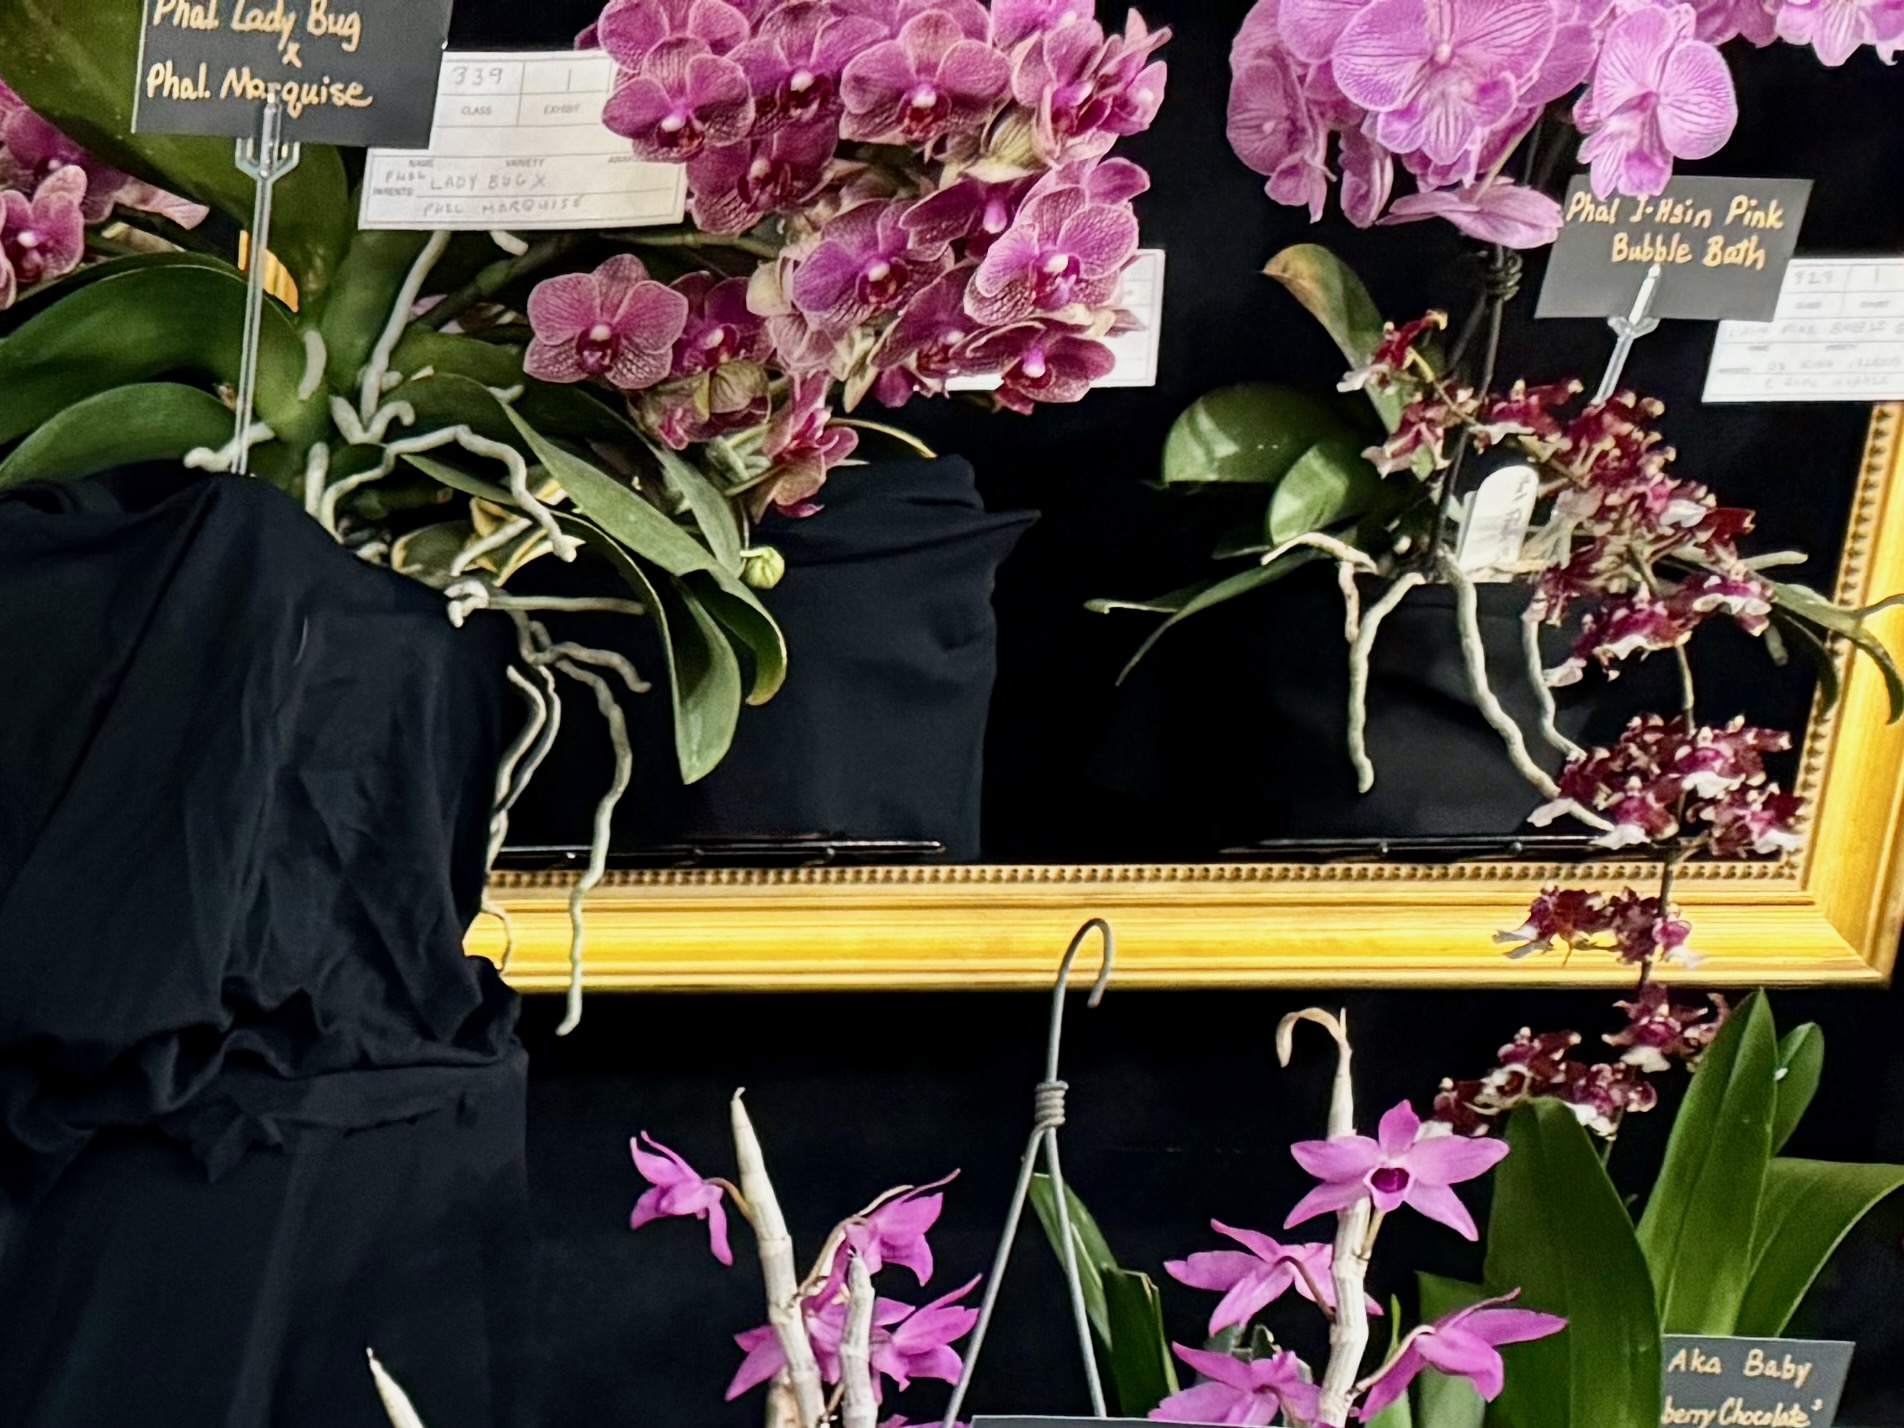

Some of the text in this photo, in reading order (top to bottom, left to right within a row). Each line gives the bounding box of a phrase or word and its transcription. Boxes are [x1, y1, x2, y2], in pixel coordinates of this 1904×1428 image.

[231, 0, 298, 50] Lady
[307, 0, 362, 51] Bug
[147, 60, 374, 118] Phal. Marquise
[1566, 191, 1620, 224] Phal
[1724, 195, 1784, 230] Pink
[1611, 232, 1766, 270] Bubble Bath
[1667, 1347, 1813, 1389] Aka Baby
